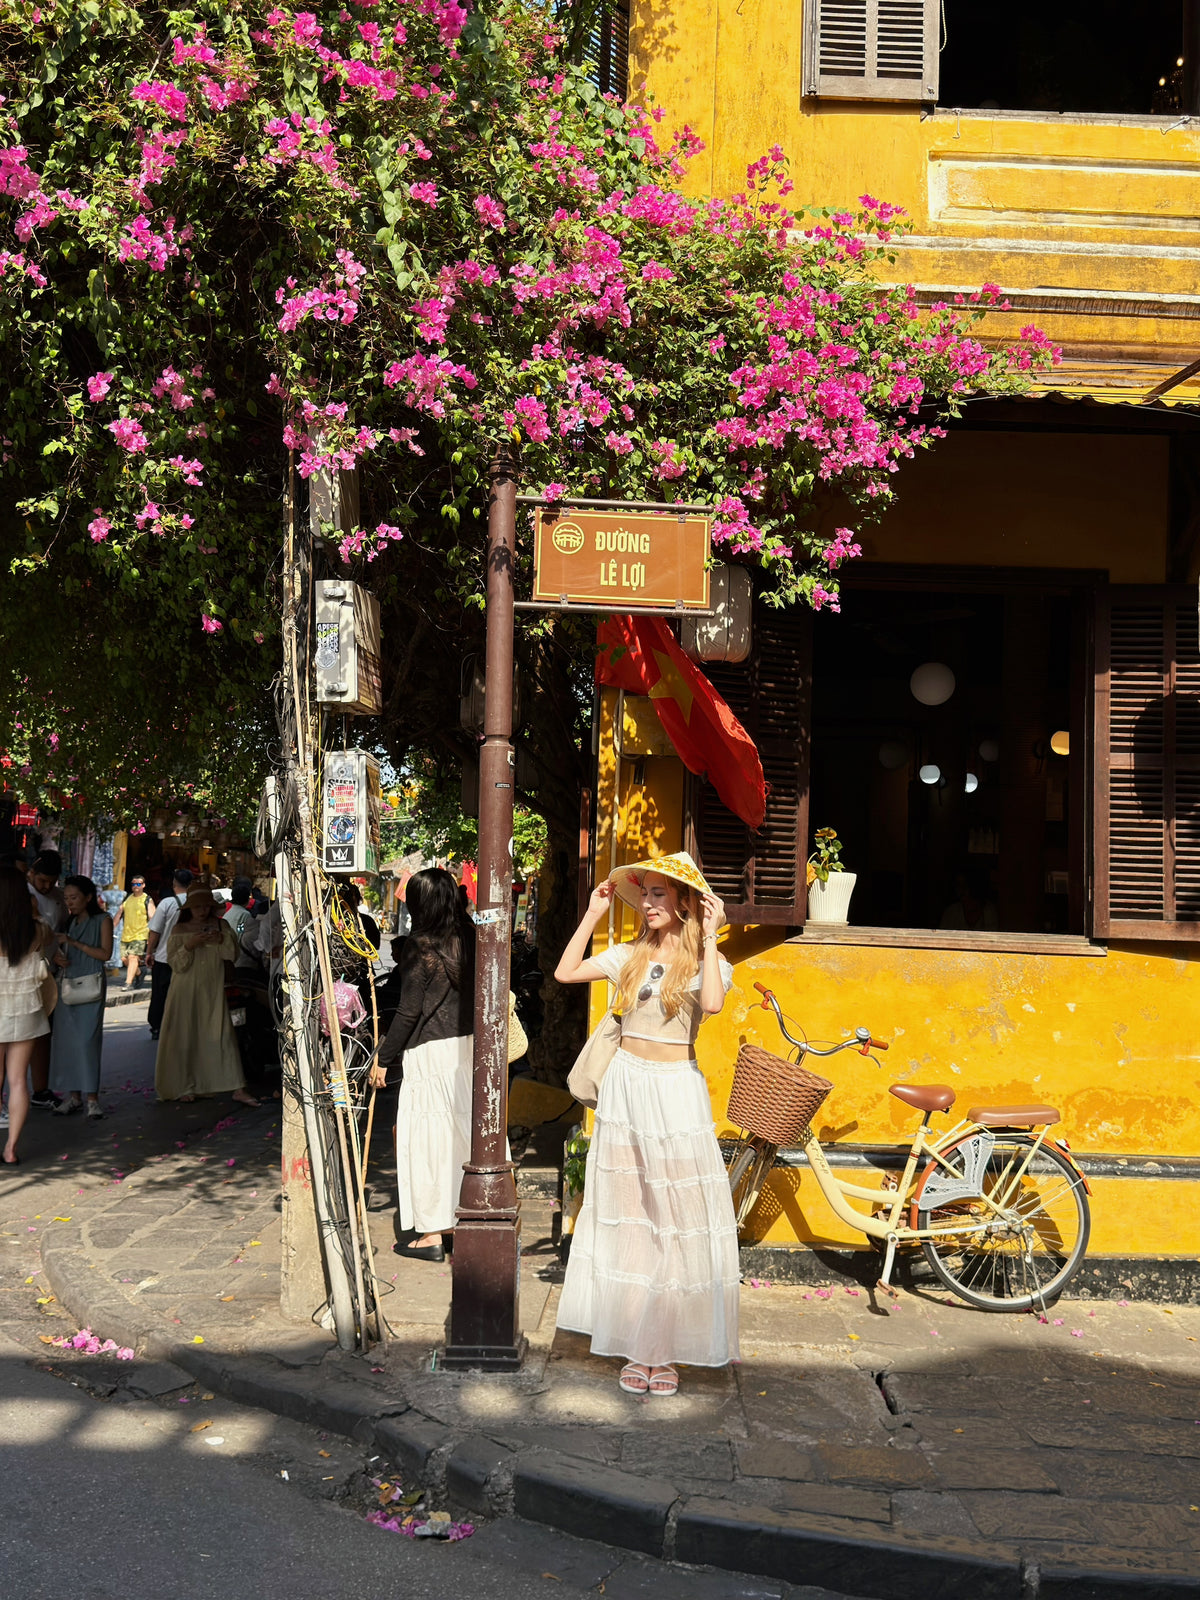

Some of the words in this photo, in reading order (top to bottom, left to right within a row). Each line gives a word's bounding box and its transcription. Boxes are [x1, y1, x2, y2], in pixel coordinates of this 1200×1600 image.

[595, 527, 651, 554] ĐƯỜNG
[600, 558, 618, 586] LÊ
[621, 561, 646, 591] LỢI
